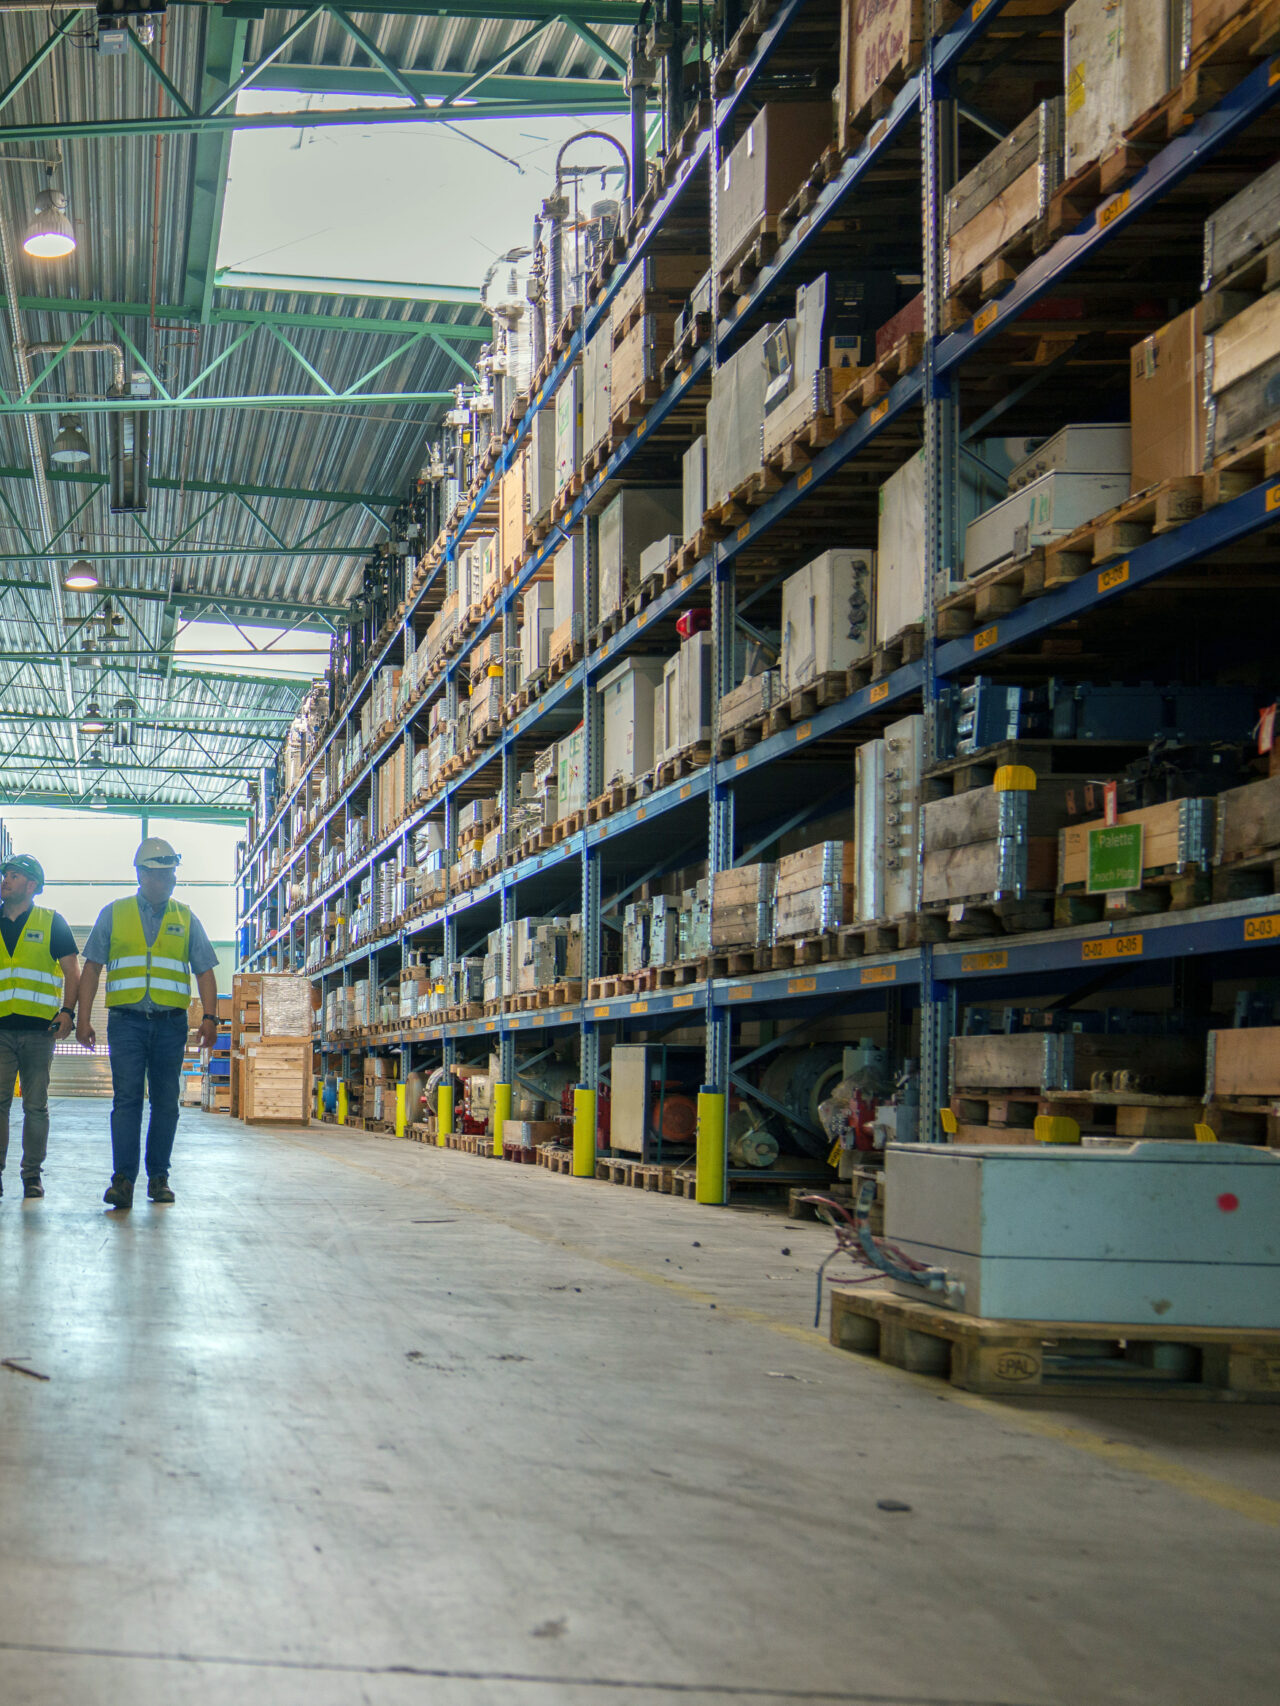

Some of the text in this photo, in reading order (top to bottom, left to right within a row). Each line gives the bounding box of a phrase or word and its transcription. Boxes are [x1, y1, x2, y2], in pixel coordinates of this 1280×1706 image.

[1097, 832, 1134, 849] Palette
[1246, 919, 1273, 937] Q-03
[1083, 937, 1137, 957] Q-02 Q-05
[997, 1358, 1031, 1375] EPAL
